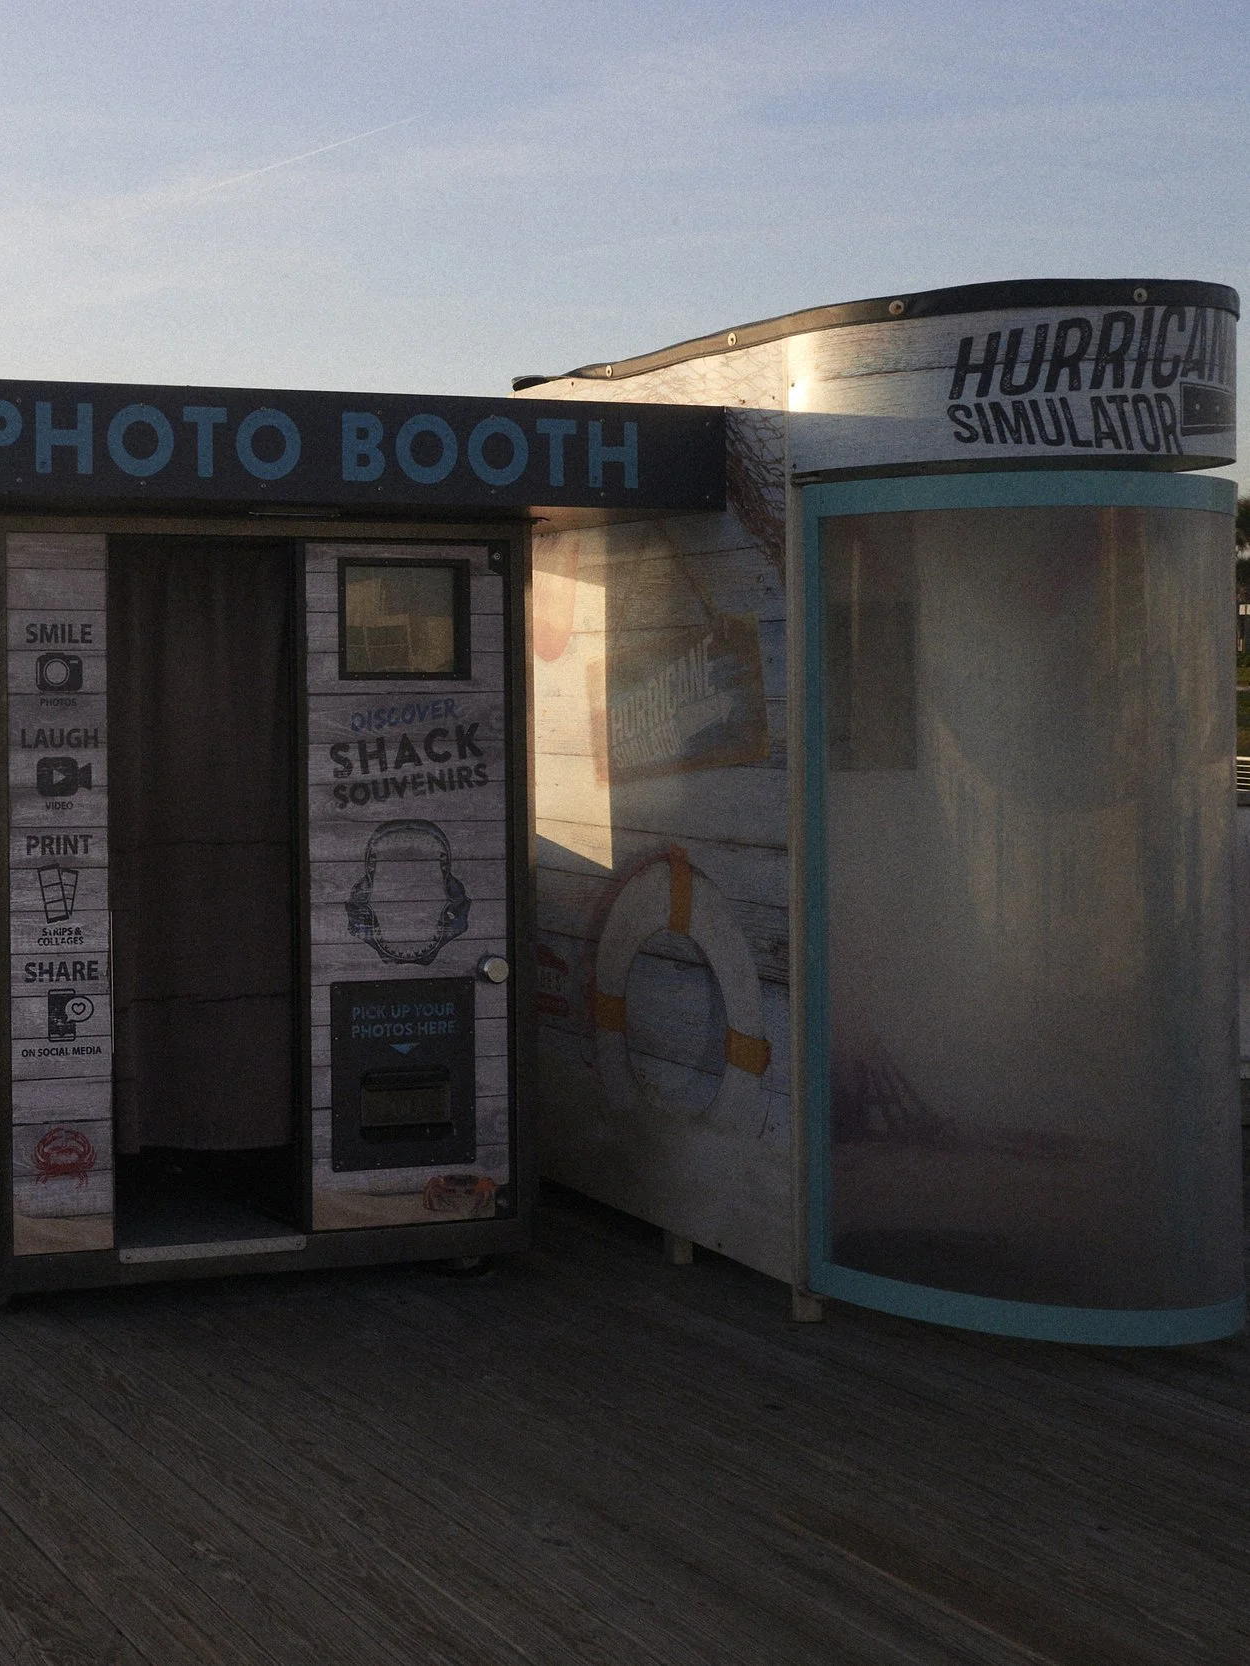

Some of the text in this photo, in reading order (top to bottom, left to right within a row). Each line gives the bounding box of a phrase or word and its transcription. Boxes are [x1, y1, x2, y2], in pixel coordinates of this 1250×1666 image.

[949, 305, 1234, 400] HURRICAN
[948, 393, 1184, 455] SIMULATOR
[343, 414, 639, 489] BOOTH
[26, 623, 93, 644] SMILE
[611, 631, 716, 746] HURRICANE
[40, 698, 77, 707] PHOTOS
[351, 698, 459, 733] DISCOVER
[21, 728, 99, 749] LAUGH
[330, 722, 484, 779] SHACK
[333, 763, 489, 809] SOUVENIRS
[45, 801, 73, 810] VIDEO
[26, 834, 93, 856] PRINT
[37, 937, 84, 946] COLLAGES
[25, 961, 99, 983] SHARE
[352, 1002, 456, 1020] PICK UP YOUR
[351, 1020, 456, 1038] PHOTOS HERE
[21, 1046, 102, 1058] ON SOCIAL MEDIA
